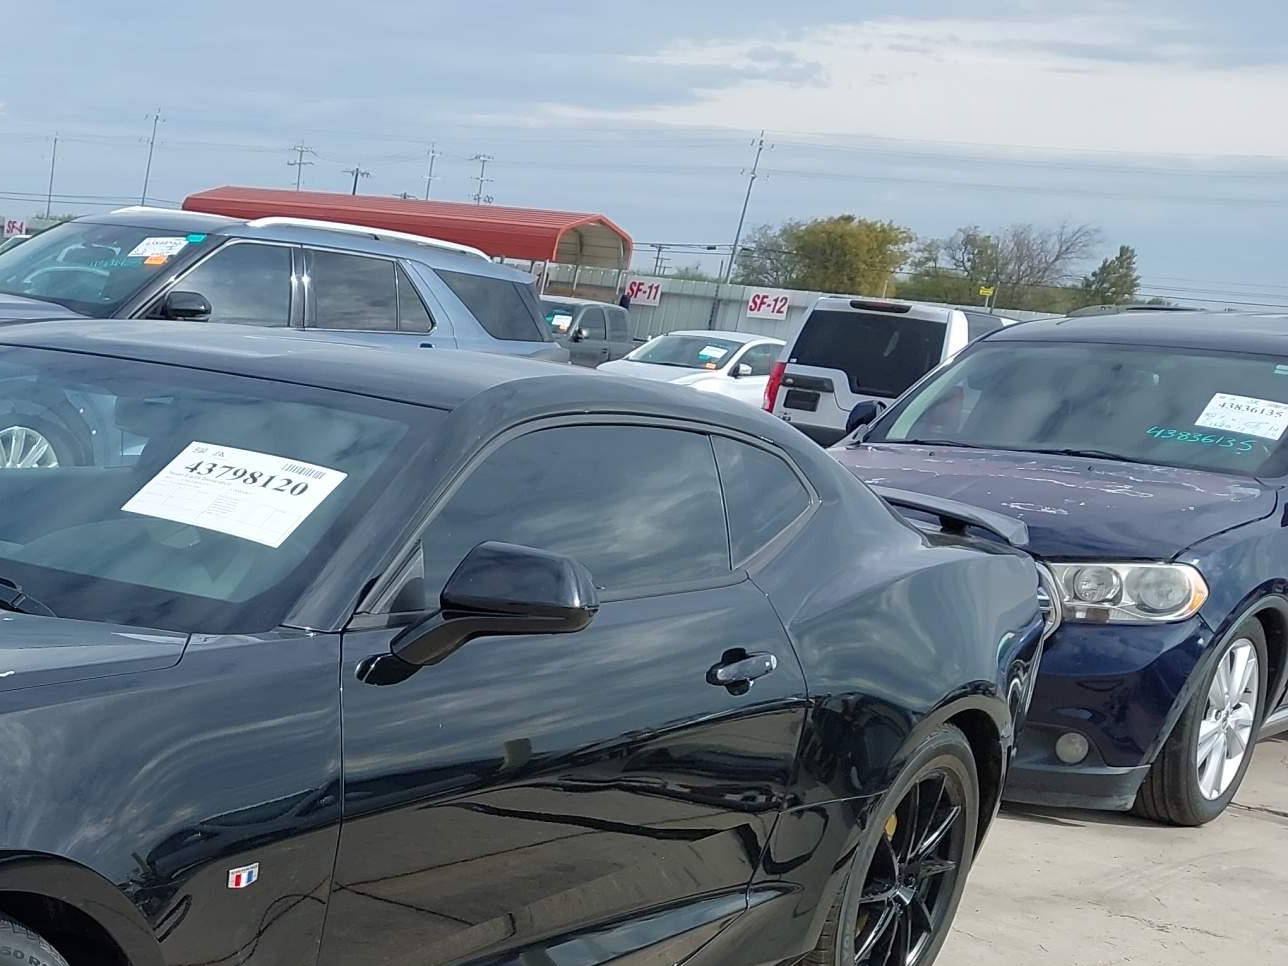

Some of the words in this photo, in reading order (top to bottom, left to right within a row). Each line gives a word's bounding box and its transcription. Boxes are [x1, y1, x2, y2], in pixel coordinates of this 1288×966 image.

[627, 281, 660, 300] SF-11
[749, 294, 788, 314] SF-12
[1219, 402, 1284, 418] 43836135
[184, 460, 309, 497] 43798120
